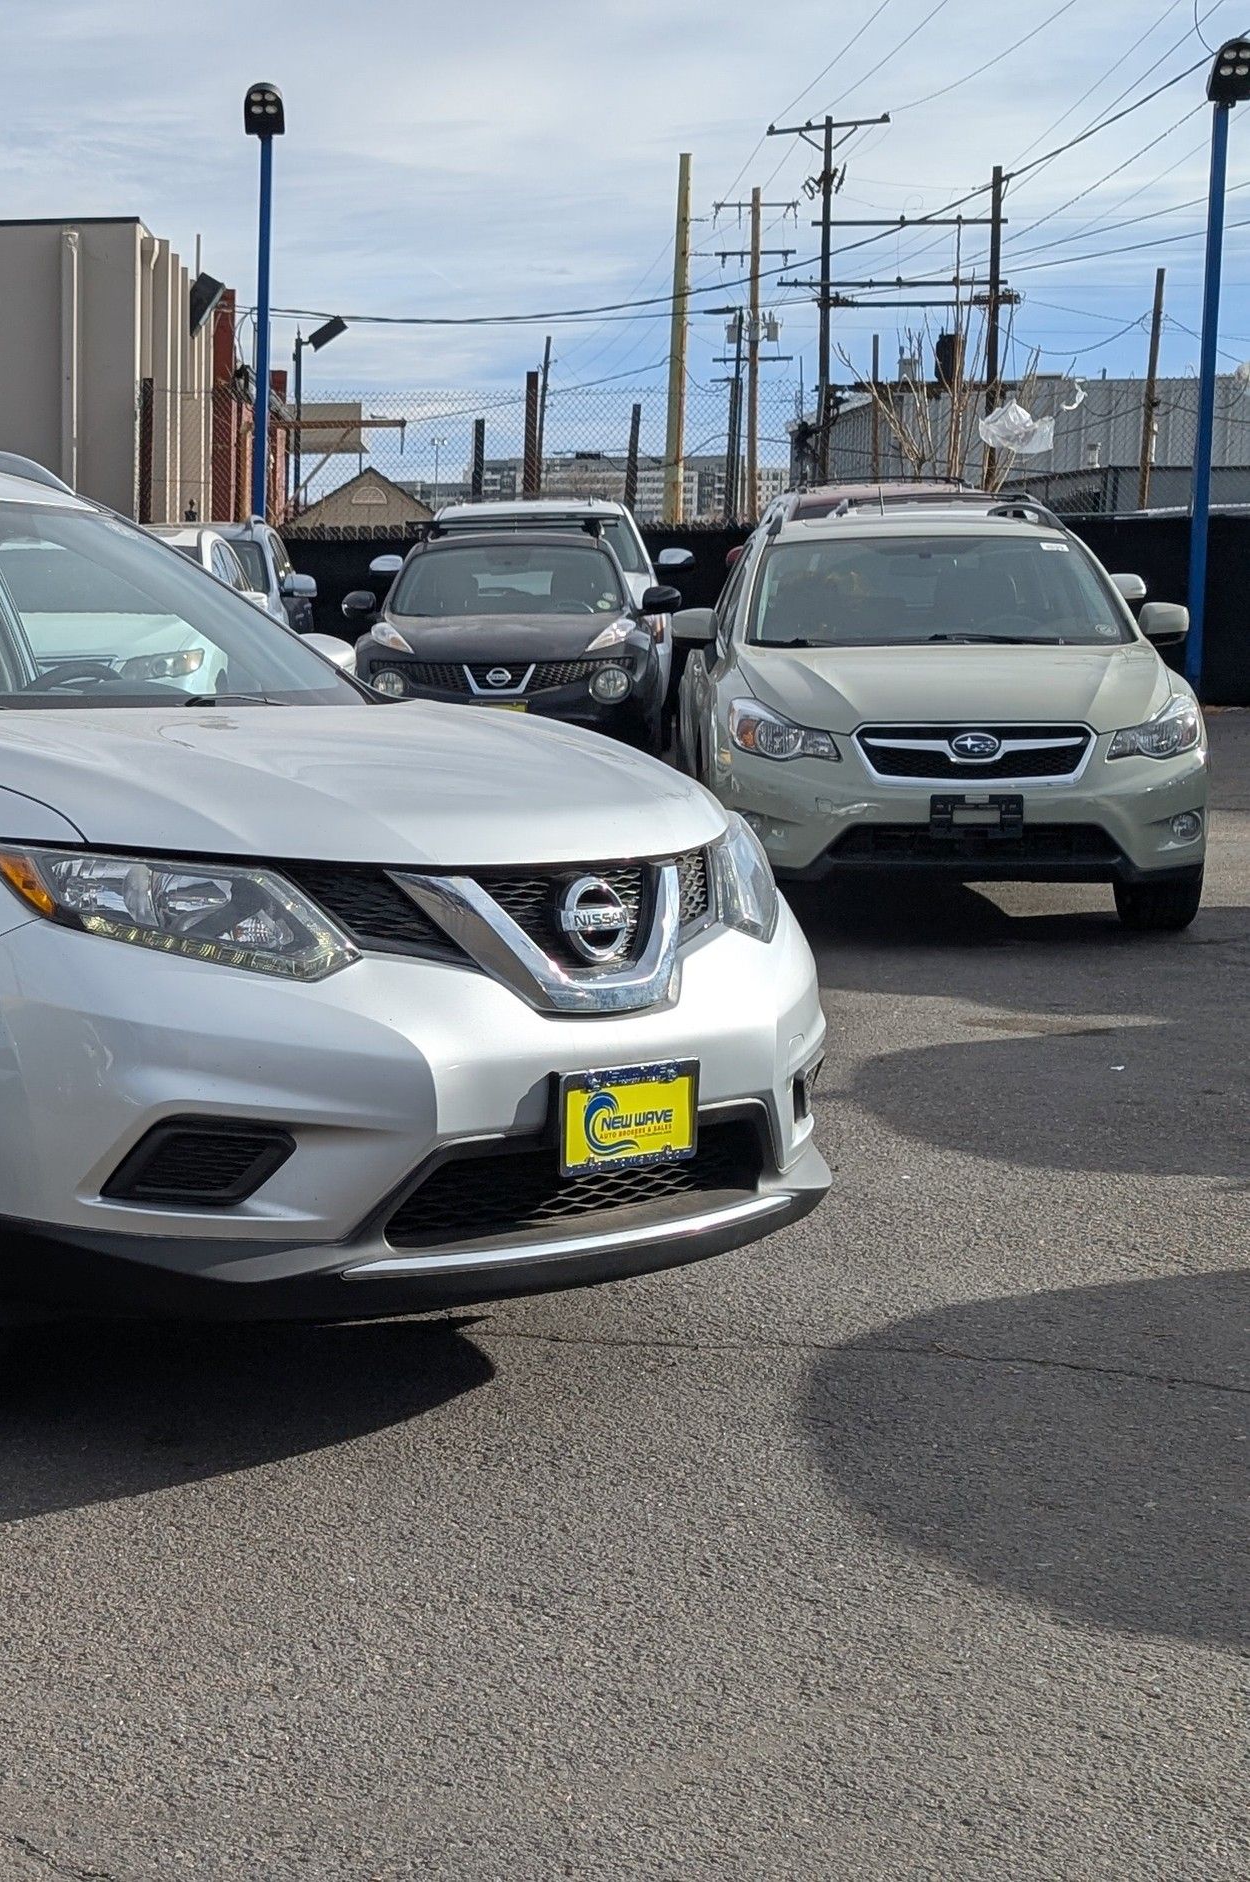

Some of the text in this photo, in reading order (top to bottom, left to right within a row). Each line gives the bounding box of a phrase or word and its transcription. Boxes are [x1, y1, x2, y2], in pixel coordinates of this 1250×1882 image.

[574, 911, 627, 927] NISSAN
[601, 1109, 673, 1131] NEW WAVE
[600, 1131, 617, 1139] AUTO
